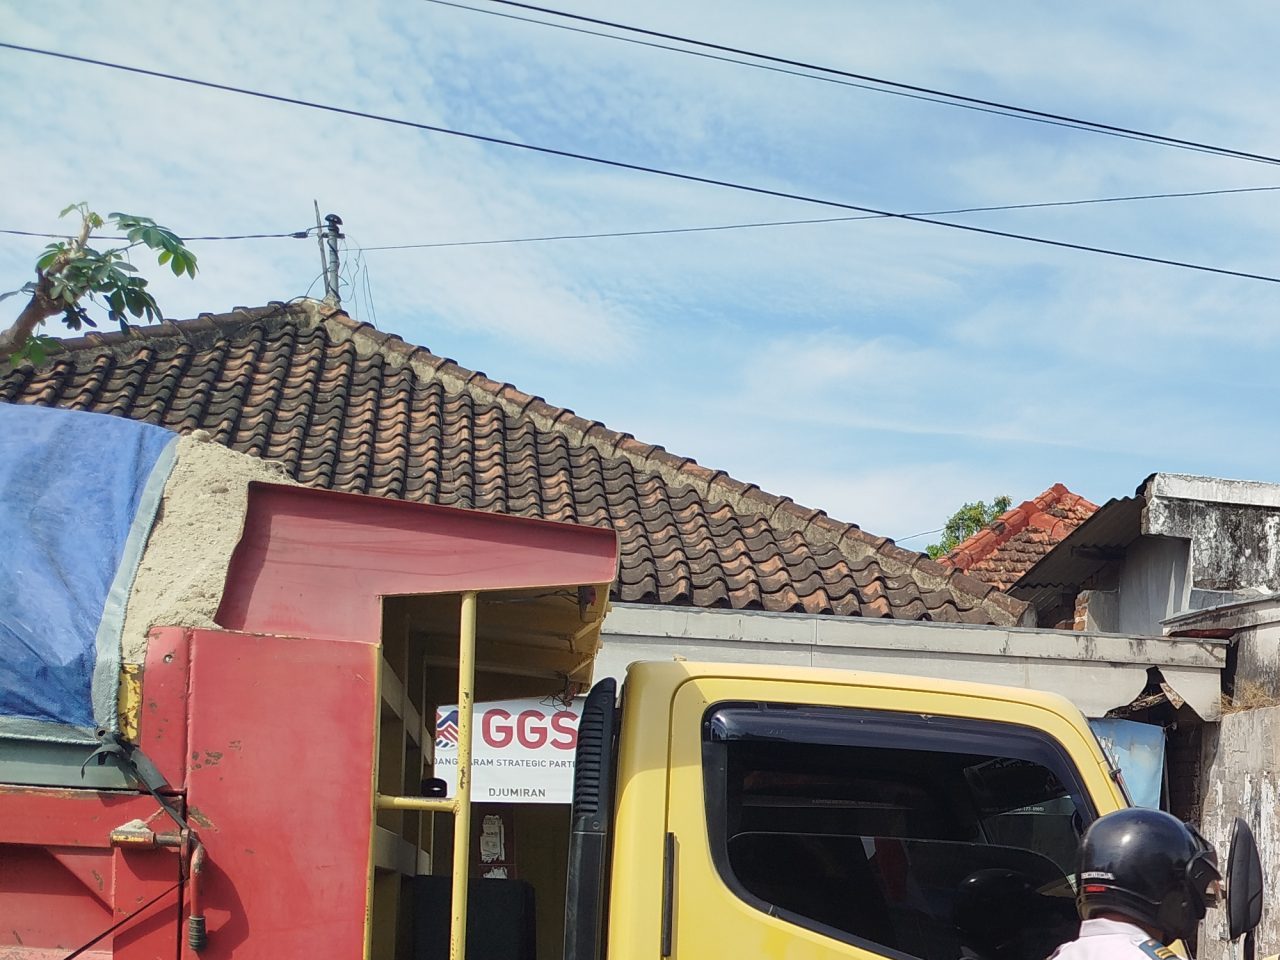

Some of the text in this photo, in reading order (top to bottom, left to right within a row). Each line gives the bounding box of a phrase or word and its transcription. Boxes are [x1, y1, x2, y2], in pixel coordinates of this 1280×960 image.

[482, 709, 578, 750] GGS
[496, 759, 547, 768] STRATEGIC
[488, 787, 547, 797] DJUMIRAN
